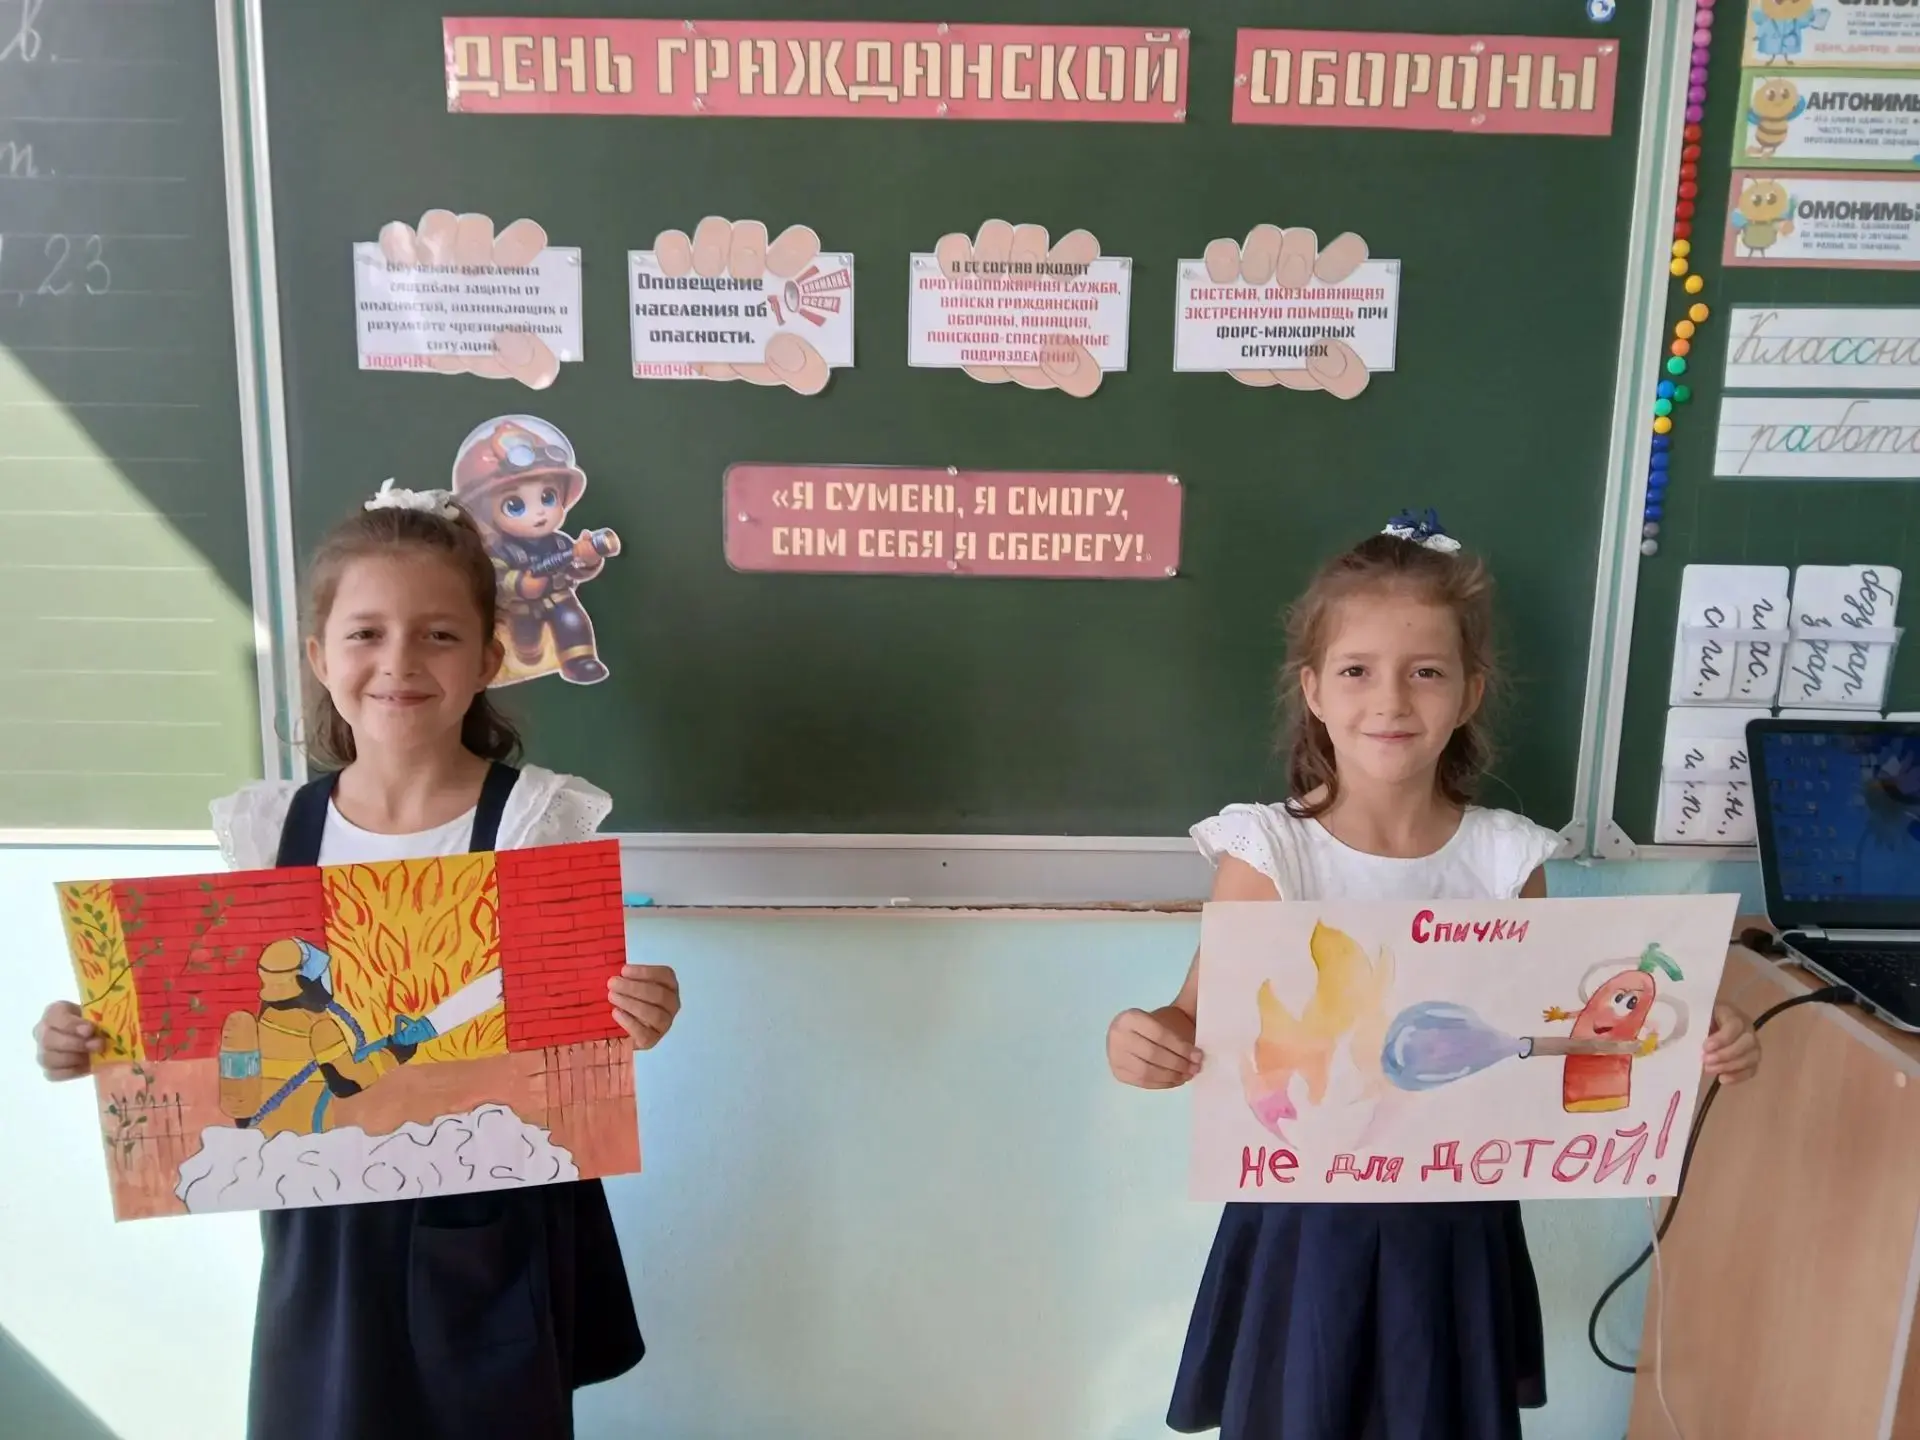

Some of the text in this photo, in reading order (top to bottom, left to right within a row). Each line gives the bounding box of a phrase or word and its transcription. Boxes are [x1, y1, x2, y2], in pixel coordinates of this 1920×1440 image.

[449, 32, 1597, 111] ДЕНЬ ГРАЖДАНСКОЙ ОБОРОНЫ
[952, 261, 960, 273] В
[983, 262, 1032, 275] СОСТАВ
[1036, 262, 1090, 276] ВХОДЯТ
[464, 283, 520, 297] защиты
[525, 285, 541, 296] от
[638, 273, 763, 292] Оповещение
[919, 278, 1121, 295] ПРОТИВОПОЖАРНАЯ СЛУЖБА,
[941, 294, 1099, 312] ВОЙСКА ГРАЖДАНСКОЙ
[1190, 287, 1385, 302] СИСТЕМА, ОКАЗЫВАЮЩАЯ
[636, 301, 767, 318] населения об
[1185, 306, 1388, 321] ЭКСТРЕННУЮ ПОМОЩЬ ПРИ
[947, 314, 1018, 329] ОБОРОНЫ,
[650, 329, 755, 344] опасности.
[1217, 325, 1356, 339] ФОРС-МАЖОРНЫХ
[1241, 345, 1328, 358] СИТУАЦИЯХ
[825, 483, 964, 518] СУМЕЮ,
[974, 487, 997, 516] Я
[1008, 486, 1129, 520] СМОГУ,
[772, 527, 847, 558] САМ
[858, 529, 943, 559] СЕБЯ
[954, 532, 976, 560] Я
[1411, 909, 1530, 943] Спички
[1325, 1152, 1404, 1184] для
[1420, 1089, 1681, 1187] детей!
